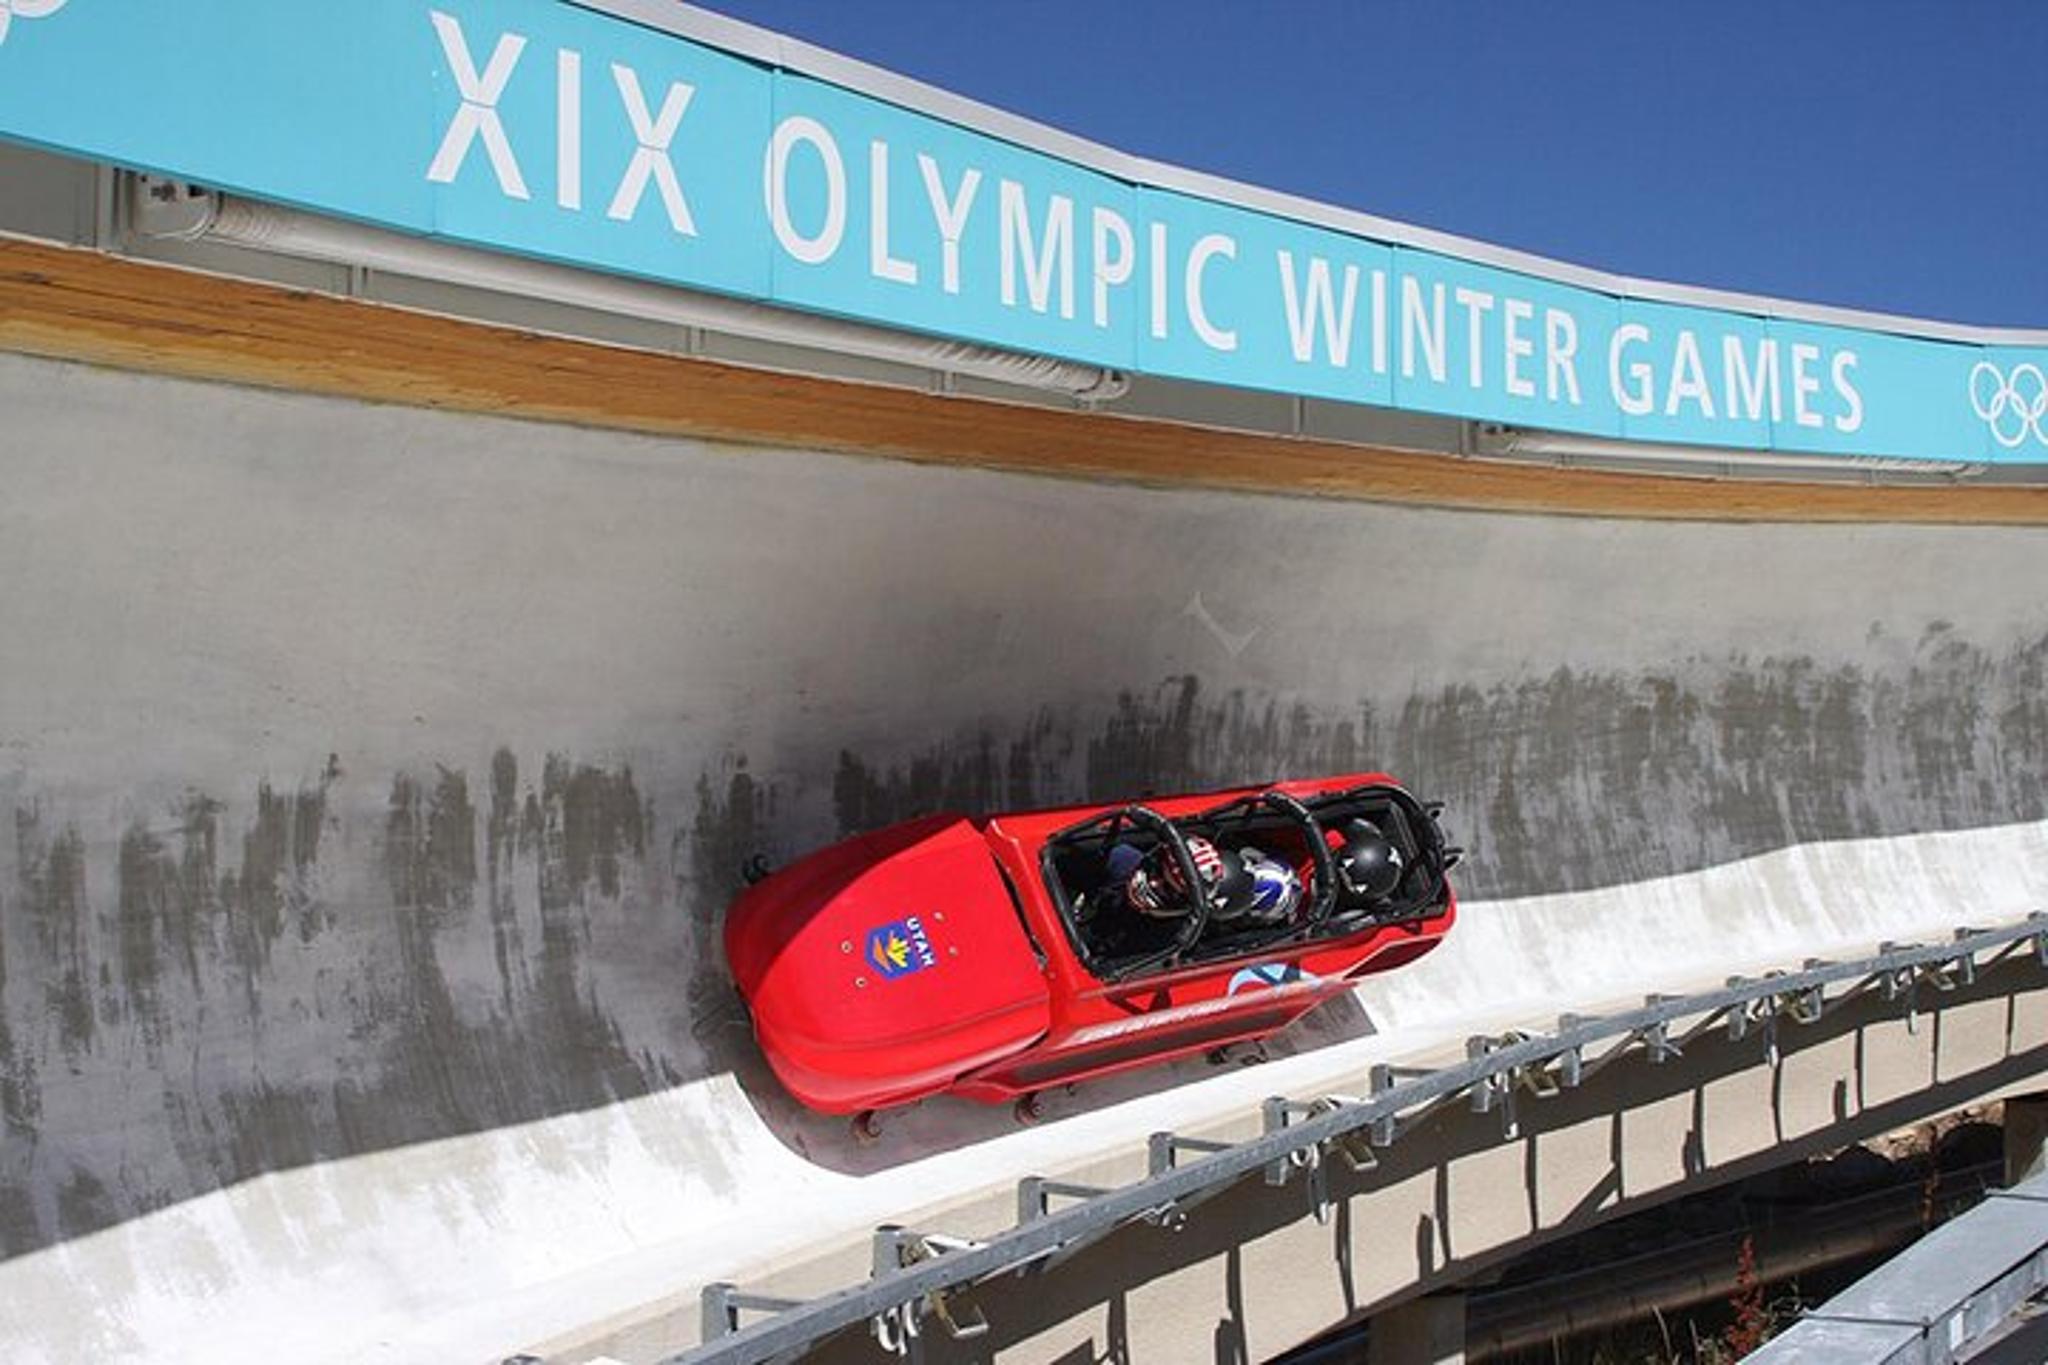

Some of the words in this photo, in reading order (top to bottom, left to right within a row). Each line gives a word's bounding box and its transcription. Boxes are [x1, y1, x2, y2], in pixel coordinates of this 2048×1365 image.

[426, 9, 697, 237] XIX
[763, 115, 1237, 352] OLYMPIC
[1278, 250, 1582, 405] WINTER
[1608, 322, 1864, 433] GAMES
[906, 916, 936, 967] UTAH
